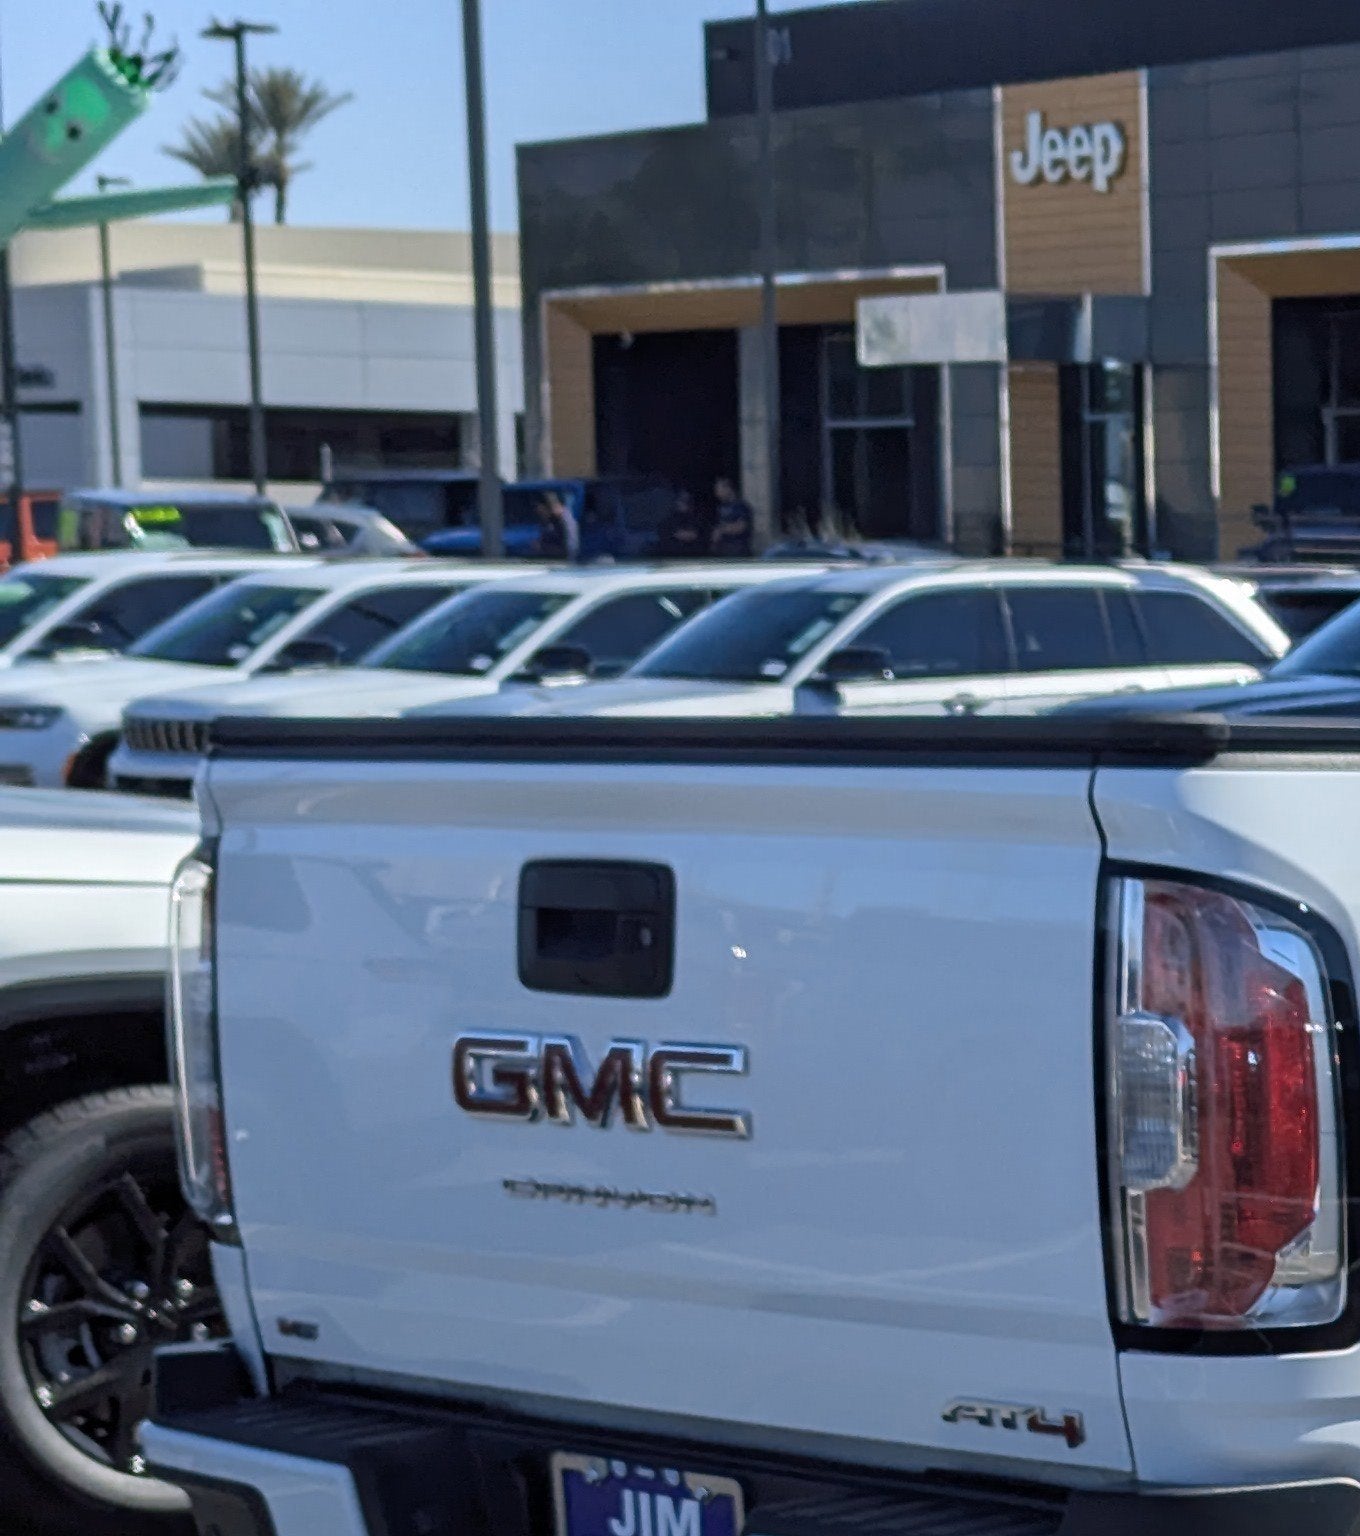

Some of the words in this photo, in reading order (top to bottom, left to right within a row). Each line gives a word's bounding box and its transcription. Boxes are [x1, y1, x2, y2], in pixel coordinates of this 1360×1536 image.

[1010, 110, 1123, 193] Jeep
[453, 1028, 754, 1142] GMC
[941, 1397, 1086, 1449] AT4
